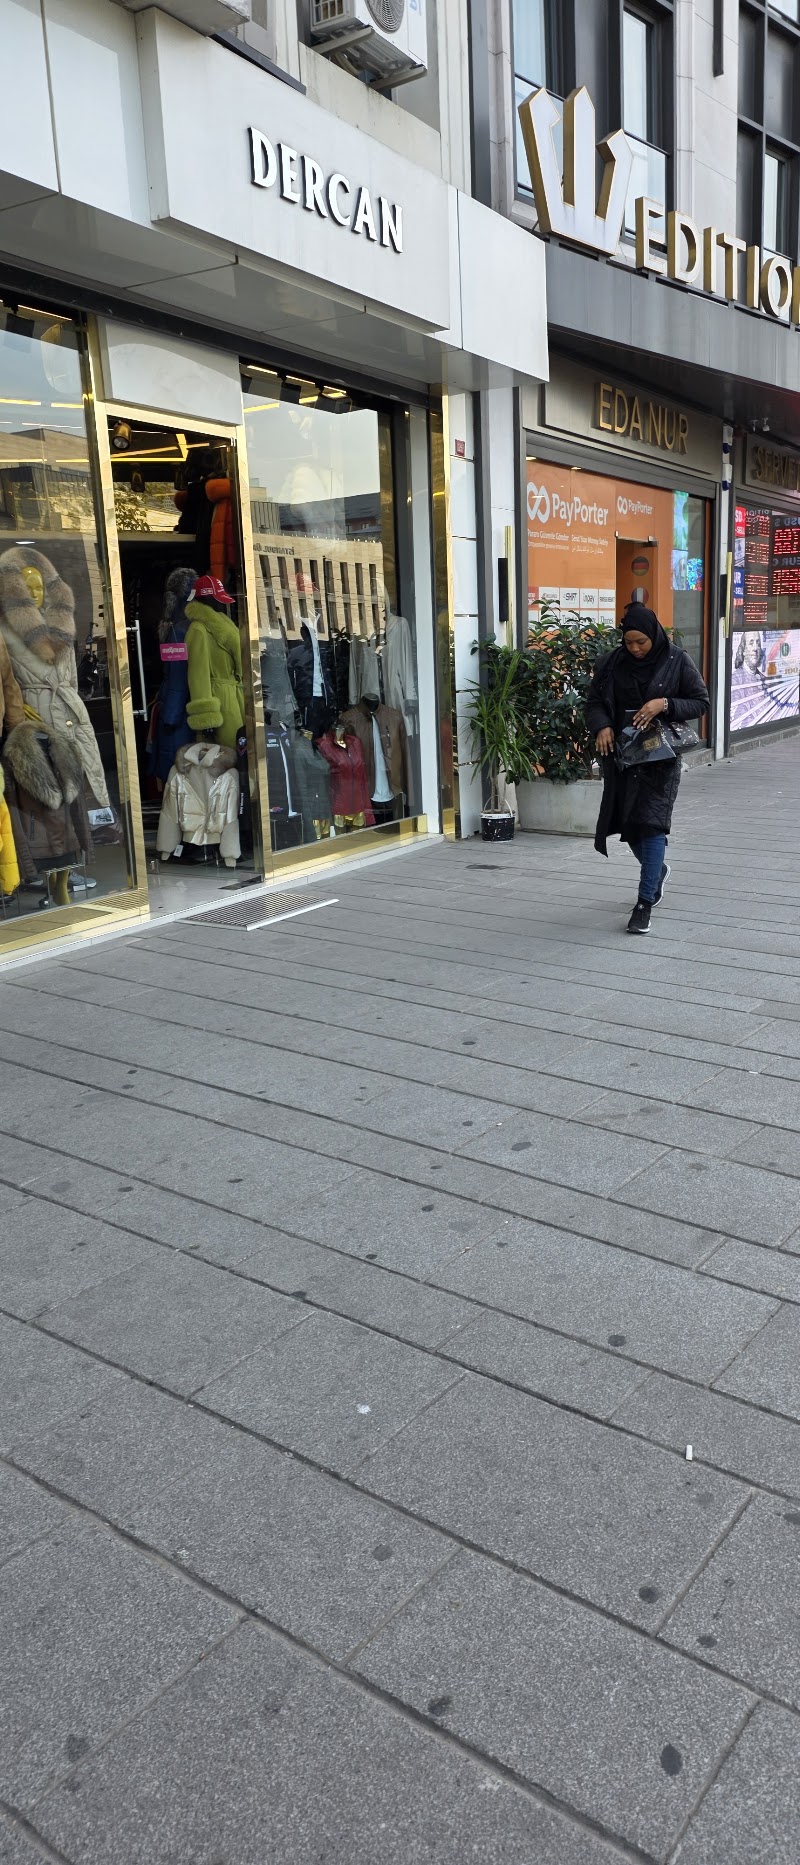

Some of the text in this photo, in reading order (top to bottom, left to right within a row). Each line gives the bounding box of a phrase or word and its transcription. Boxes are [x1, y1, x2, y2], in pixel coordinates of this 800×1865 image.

[247, 127, 403, 253] DERCAN
[552, 493, 609, 527] PayPorter
[627, 499, 653, 515] PayPorter
